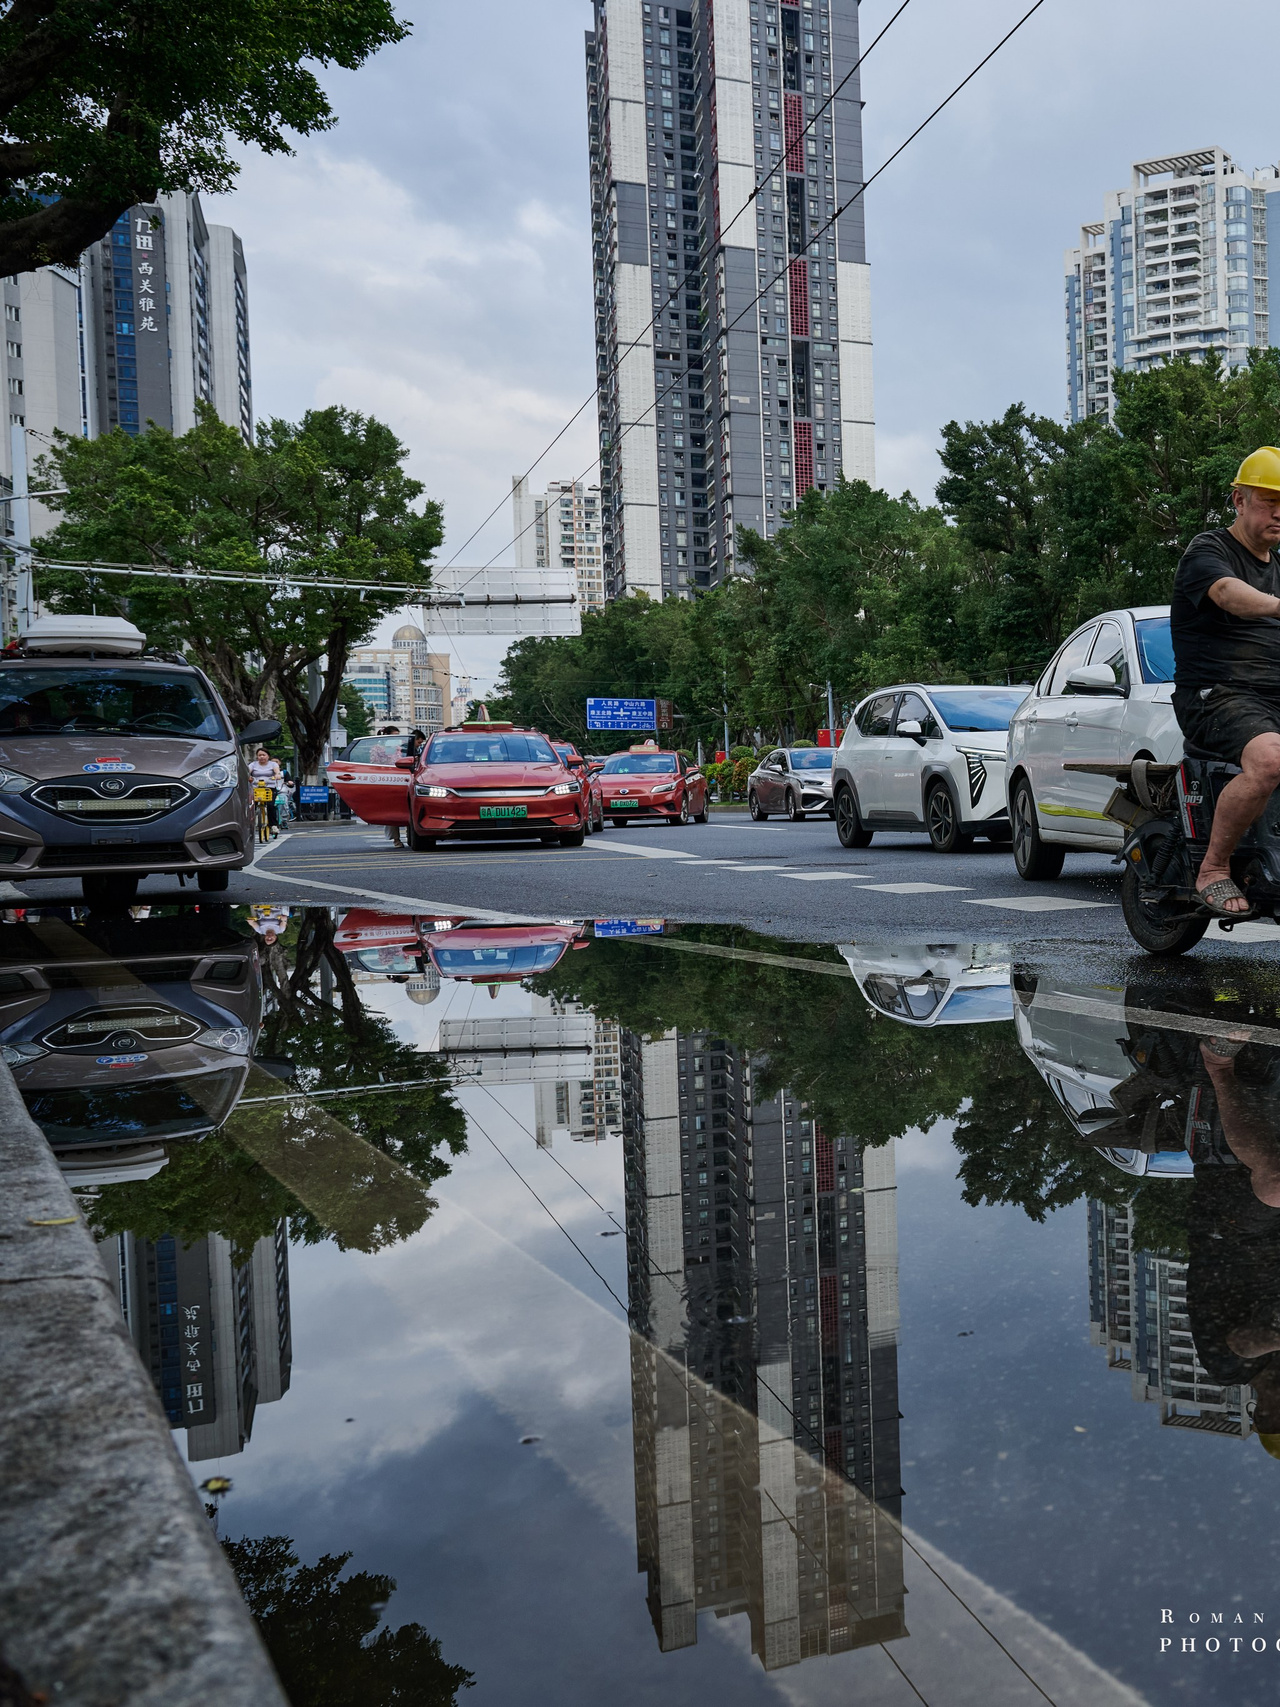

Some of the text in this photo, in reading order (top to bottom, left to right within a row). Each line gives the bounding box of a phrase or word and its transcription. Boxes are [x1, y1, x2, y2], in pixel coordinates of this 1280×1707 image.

[137, 262, 158, 332] 西关雅苑
[1184, 795, 1204, 804] 009
[495, 806, 527, 817] DU1425
